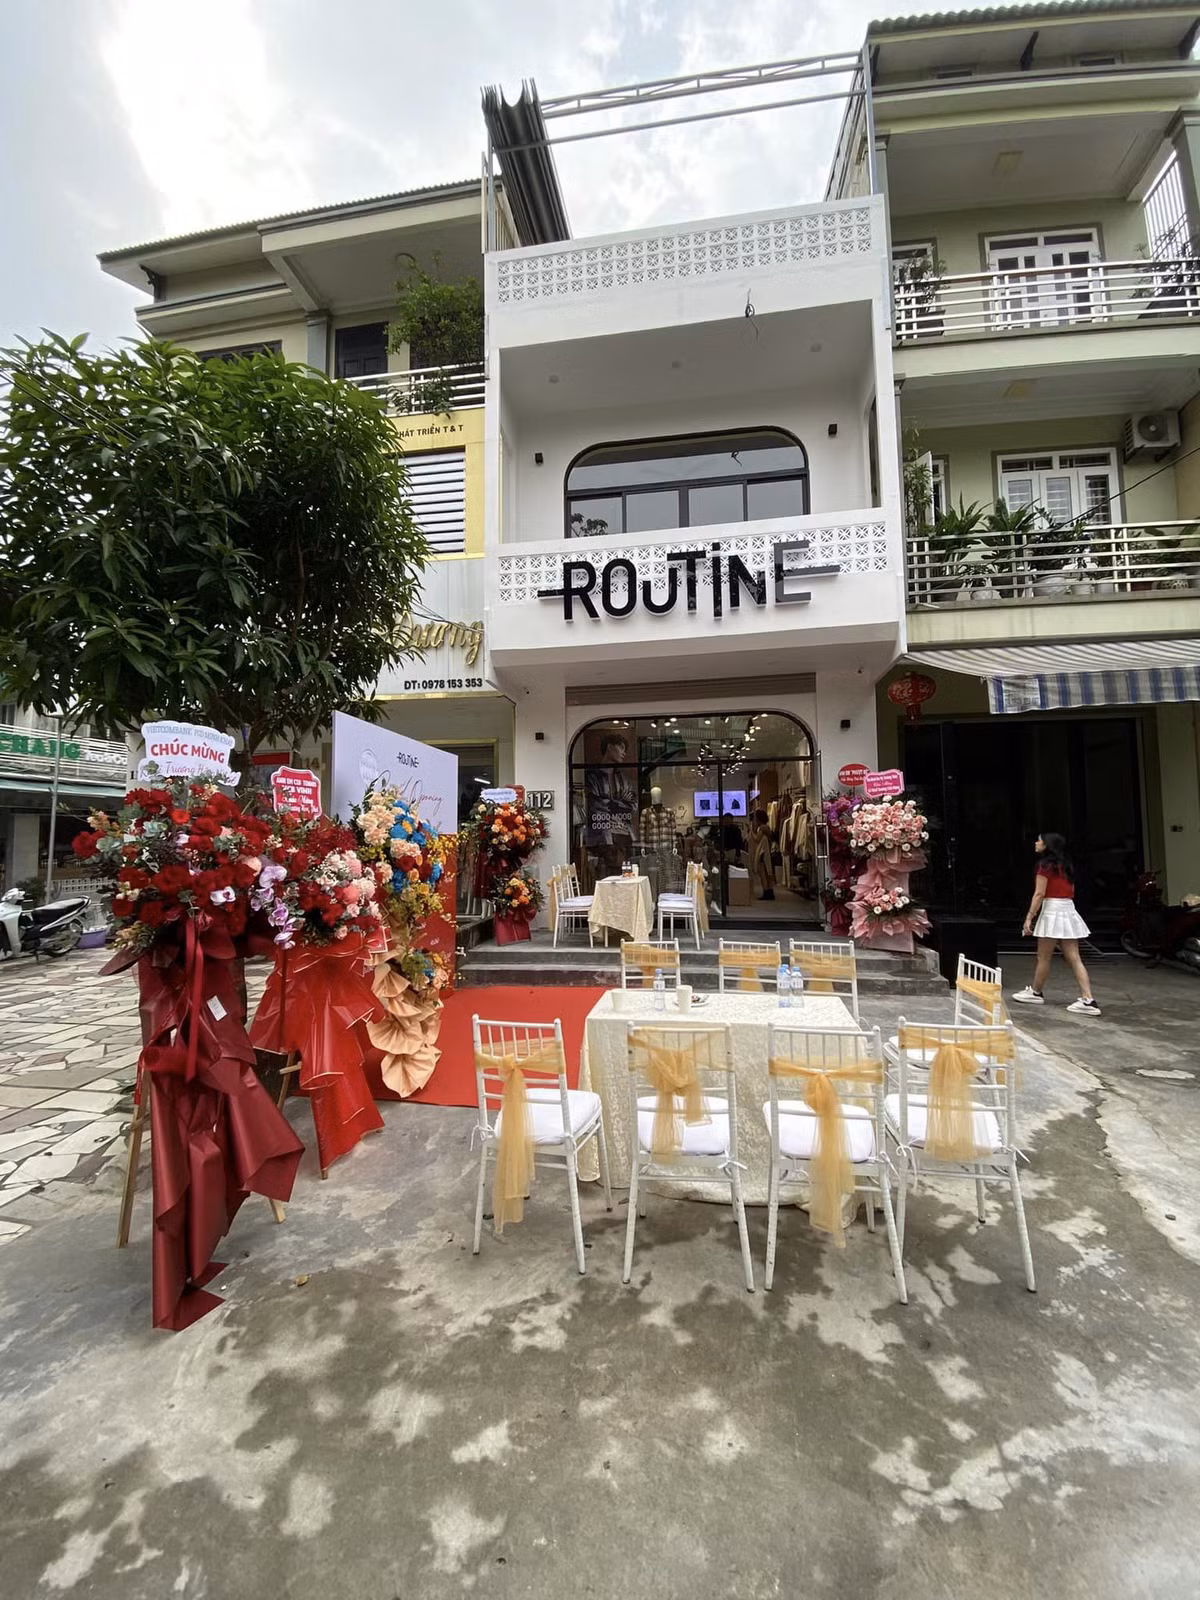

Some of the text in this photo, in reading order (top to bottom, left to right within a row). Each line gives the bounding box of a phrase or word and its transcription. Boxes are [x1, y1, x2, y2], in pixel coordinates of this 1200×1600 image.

[397, 428, 415, 438] HÁT
[417, 423, 440, 436] TRIỂN
[537, 541, 841, 621] ROUTINE
[421, 680, 445, 689] 0978
[447, 679, 463, 688] 153
[465, 678, 483, 687] 353
[151, 738, 225, 763] CHÚC MỪNG
[528, 792, 552, 808] 112
[591, 813, 632, 821] GOOD MOOD
[591, 822, 611, 830] GOOD
